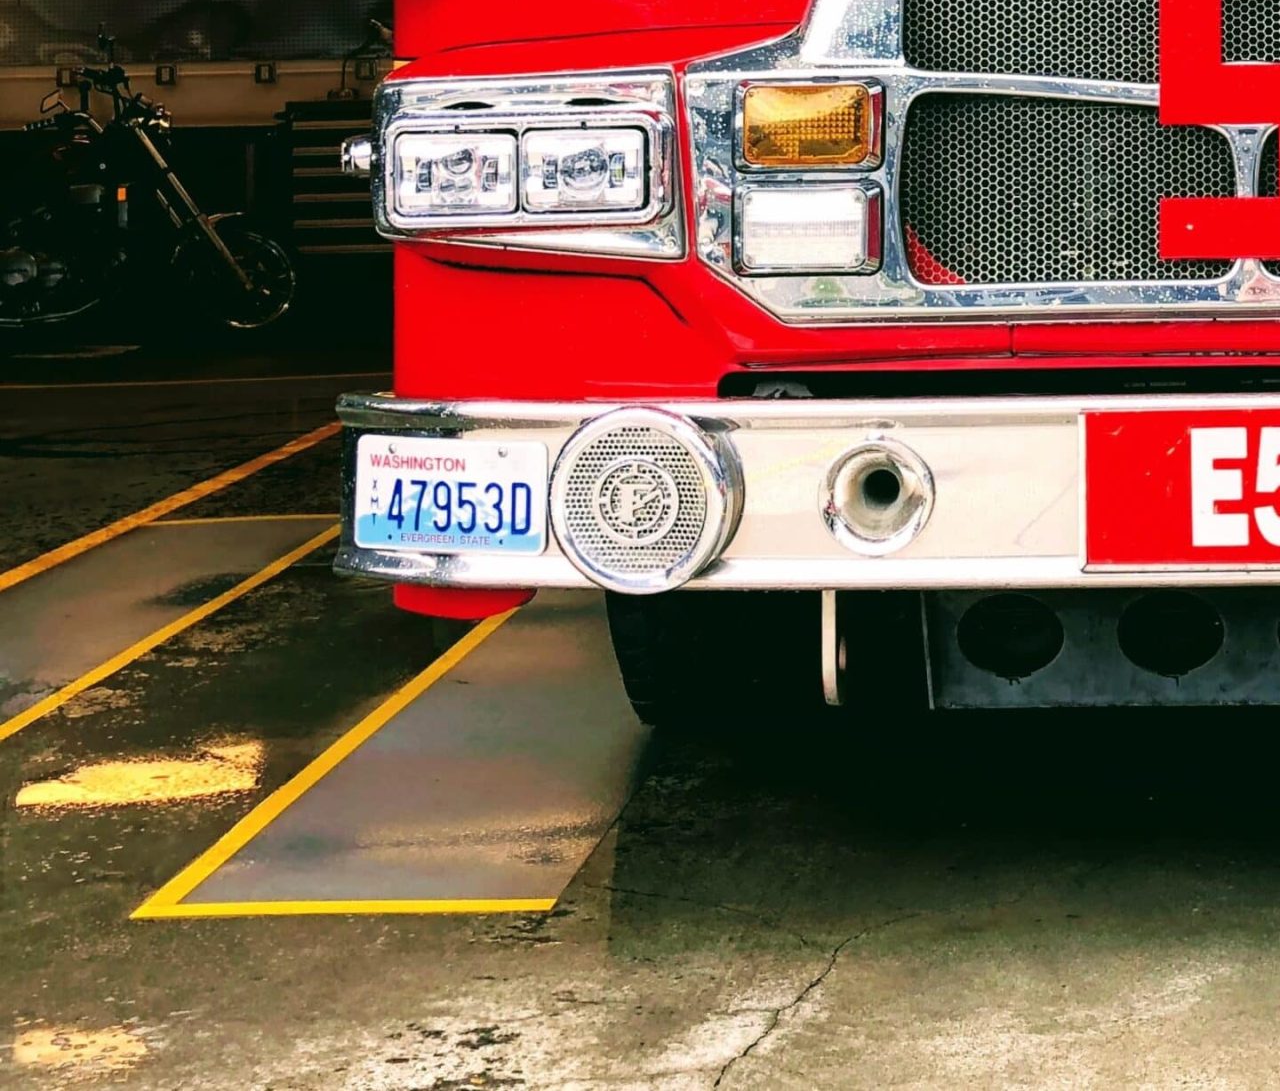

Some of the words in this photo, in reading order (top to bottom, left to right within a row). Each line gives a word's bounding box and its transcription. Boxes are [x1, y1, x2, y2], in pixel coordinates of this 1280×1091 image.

[370, 454, 466, 471] WASHINGTON
[387, 477, 533, 536] 47953D
[400, 533, 455, 545] EVERGREEN
[459, 535, 491, 546] STATE
